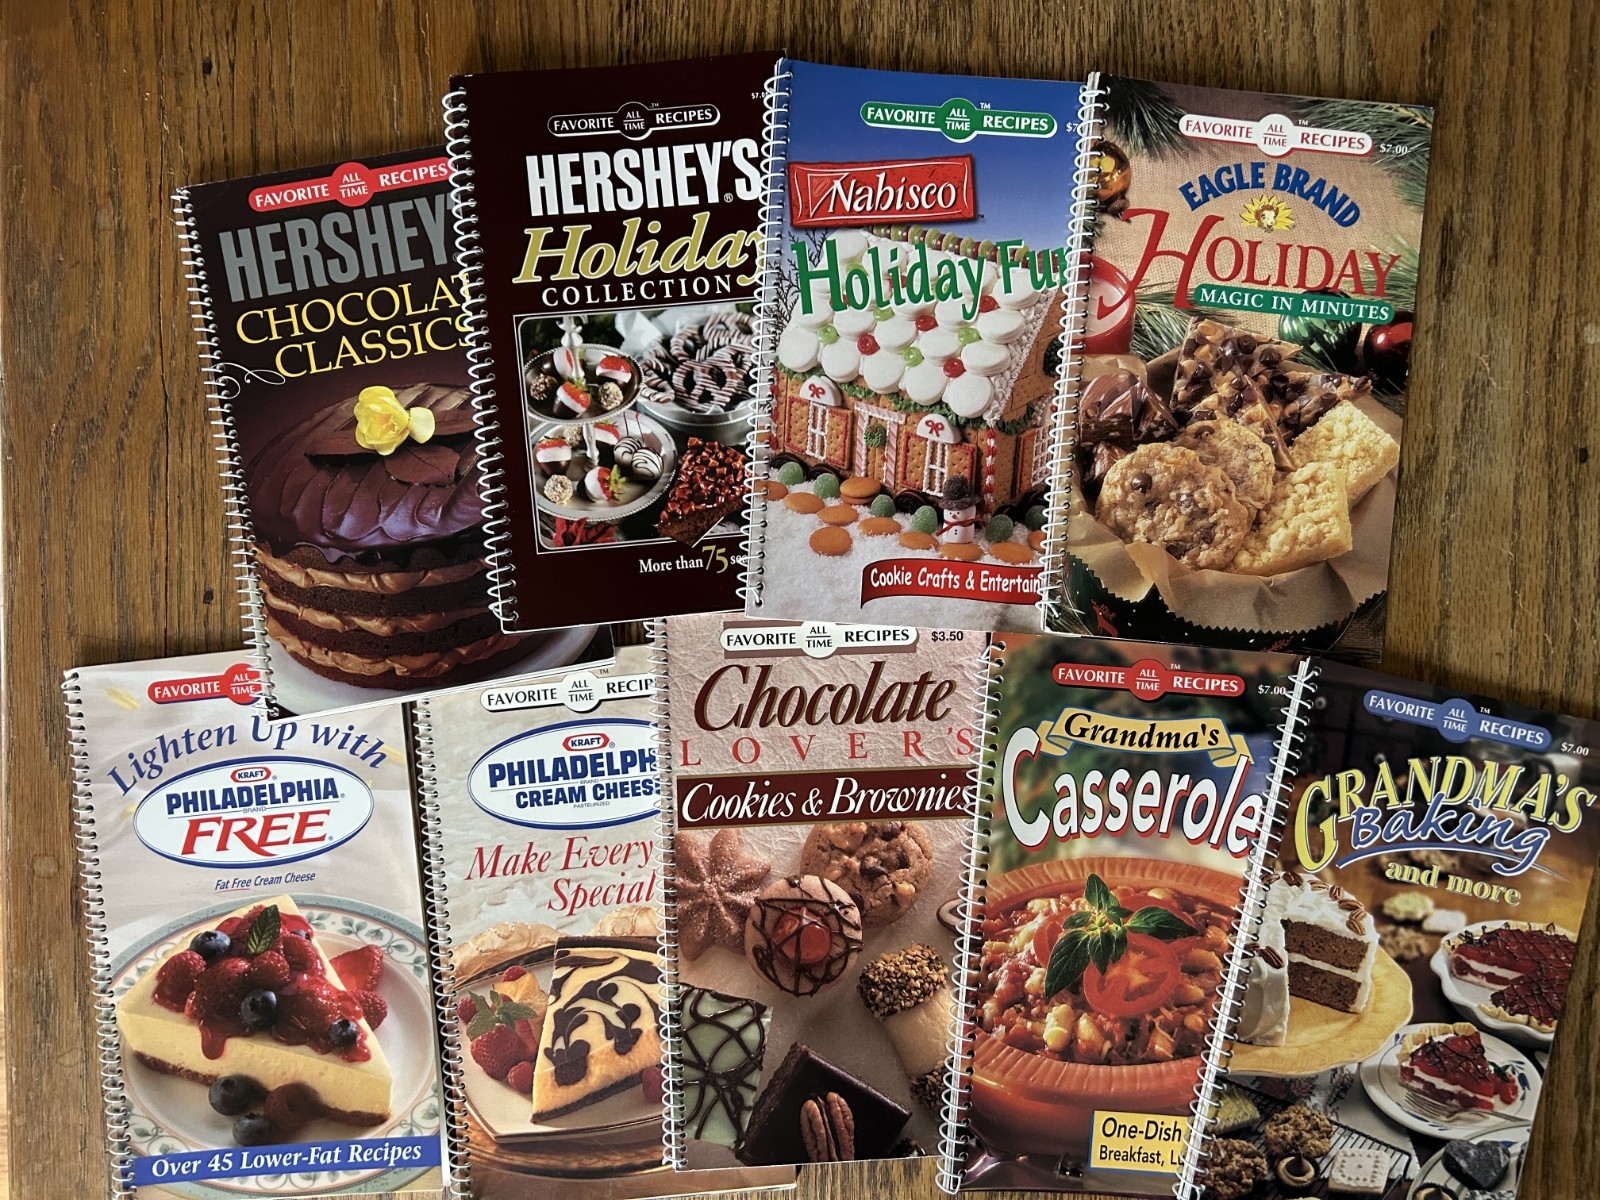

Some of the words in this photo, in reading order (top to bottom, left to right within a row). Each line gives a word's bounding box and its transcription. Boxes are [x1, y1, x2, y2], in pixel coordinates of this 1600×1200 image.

[626, 110, 641, 119] ALL
[655, 109, 712, 124] RECIPES
[866, 107, 935, 125] FAVORITE
[950, 108, 967, 117] ALL
[553, 117, 614, 132] FAVORITE
[623, 121, 645, 131] TIME
[945, 121, 970, 131] TIME
[983, 115, 1049, 132] RECIPES
[1185, 119, 1253, 139] FAVORITE
[1267, 123, 1285, 133] ALL
[1262, 136, 1287, 147] TIME
[1300, 133, 1365, 150] RECIPES
[1379, 143, 1408, 155] $7.00
[342, 172, 361, 184] ALL
[379, 163, 448, 187] RECIPES
[525, 138, 762, 216] HERSHEY'S
[255, 183, 330, 208] FAVORITE
[339, 185, 369, 199] TIME
[828, 171, 956, 213] Nabisco
[1178, 161, 1267, 211] EAGLE
[1272, 162, 1361, 228] BRAND
[219, 193, 461, 303] HERSHEY'
[512, 211, 765, 287] Holiday
[1096, 208, 1400, 320] HOLIDAY
[791, 239, 987, 321] Holiday
[541, 274, 732, 307] COLLECTION
[1200, 288, 1264, 309] MAGIC
[1271, 294, 1293, 311] IN
[1301, 297, 1389, 321] MINUTES
[275, 313, 475, 378] CLASSICS
[639, 558, 673, 573] More
[676, 555, 704, 570] than
[702, 545, 728, 574] 75
[870, 565, 912, 588] Cookie
[917, 567, 960, 590] Crafts
[965, 570, 975, 591] &
[726, 632, 797, 647] FAVORITE
[810, 626, 827, 635] ALL
[844, 630, 910, 643] RECIPES
[931, 631, 964, 643] $3.50
[805, 638, 833, 649] TIME
[234, 673, 250, 682] ALL
[1058, 668, 1125, 684] FAVORITE
[1140, 668, 1157, 678] ALL
[154, 681, 221, 698] FAVORITE
[231, 685, 255, 695] TIME
[571, 680, 589, 689] ALL
[606, 678, 656, 694] RECIP
[1135, 681, 1160, 692] TIME
[1173, 676, 1238, 692] RECIPES
[1258, 684, 1286, 695] $7.00
[487, 687, 558, 706] FAVORITE
[568, 692, 594, 702] TIME
[694, 660, 957, 732] Chocolate
[1369, 695, 1435, 721] FAVORITE
[1448, 707, 1465, 719] ALL
[1064, 712, 1220, 749] Grandma's
[1443, 720, 1468, 733] TIME
[1479, 720, 1544, 745] RECIPES
[570, 737, 602, 747] KRAFT
[680, 727, 974, 767] LOVER'S
[1560, 742, 1590, 756] $7.00
[107, 723, 237, 796] Lighten
[251, 715, 298, 750] Up
[311, 724, 387, 769] with
[237, 770, 264, 779] KRAFT
[166, 777, 339, 815] PHILADELPHIA
[515, 783, 587, 809] CREAM
[681, 780, 796, 823] Cookies
[801, 788, 823, 817] &
[827, 773, 971, 816] Brownies
[1002, 726, 1262, 857] Casserole
[1294, 755, 1598, 873] GRANDMA'S
[181, 809, 331, 857] FREE
[1351, 791, 1550, 877] Baking
[464, 841, 551, 881] Make
[560, 835, 654, 872] Every
[215, 879, 230, 890] Fat
[231, 878, 251, 889] Free
[254, 875, 282, 887] Cream
[285, 872, 316, 884] Cheese
[1385, 860, 1441, 889] and
[1445, 873, 1522, 906] more
[547, 870, 656, 916] Special
[1102, 1117, 1182, 1142] One-Dish
[152, 1158, 202, 1178] Over
[207, 1153, 233, 1172] 45
[240, 1146, 342, 1170] Lower-Fat
[347, 1142, 422, 1167] Recipes
[1099, 1144, 1165, 1167] Breakfast,
